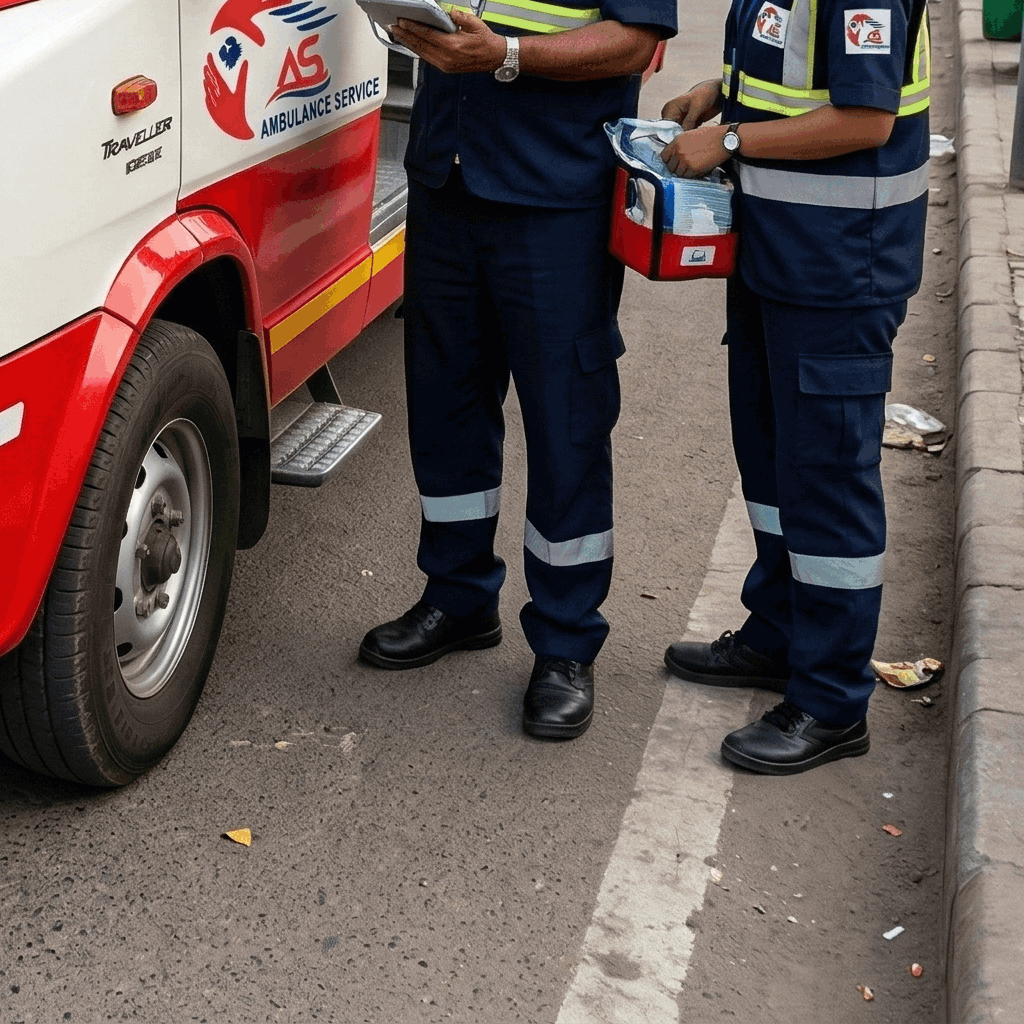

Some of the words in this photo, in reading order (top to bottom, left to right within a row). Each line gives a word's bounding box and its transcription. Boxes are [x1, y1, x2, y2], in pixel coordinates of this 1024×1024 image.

[274, 33, 327, 94] AS
[101, 116, 173, 160] TRAVELLER
[260, 97, 332, 140] AMBULANCE
[334, 77, 380, 111] SERVICE
